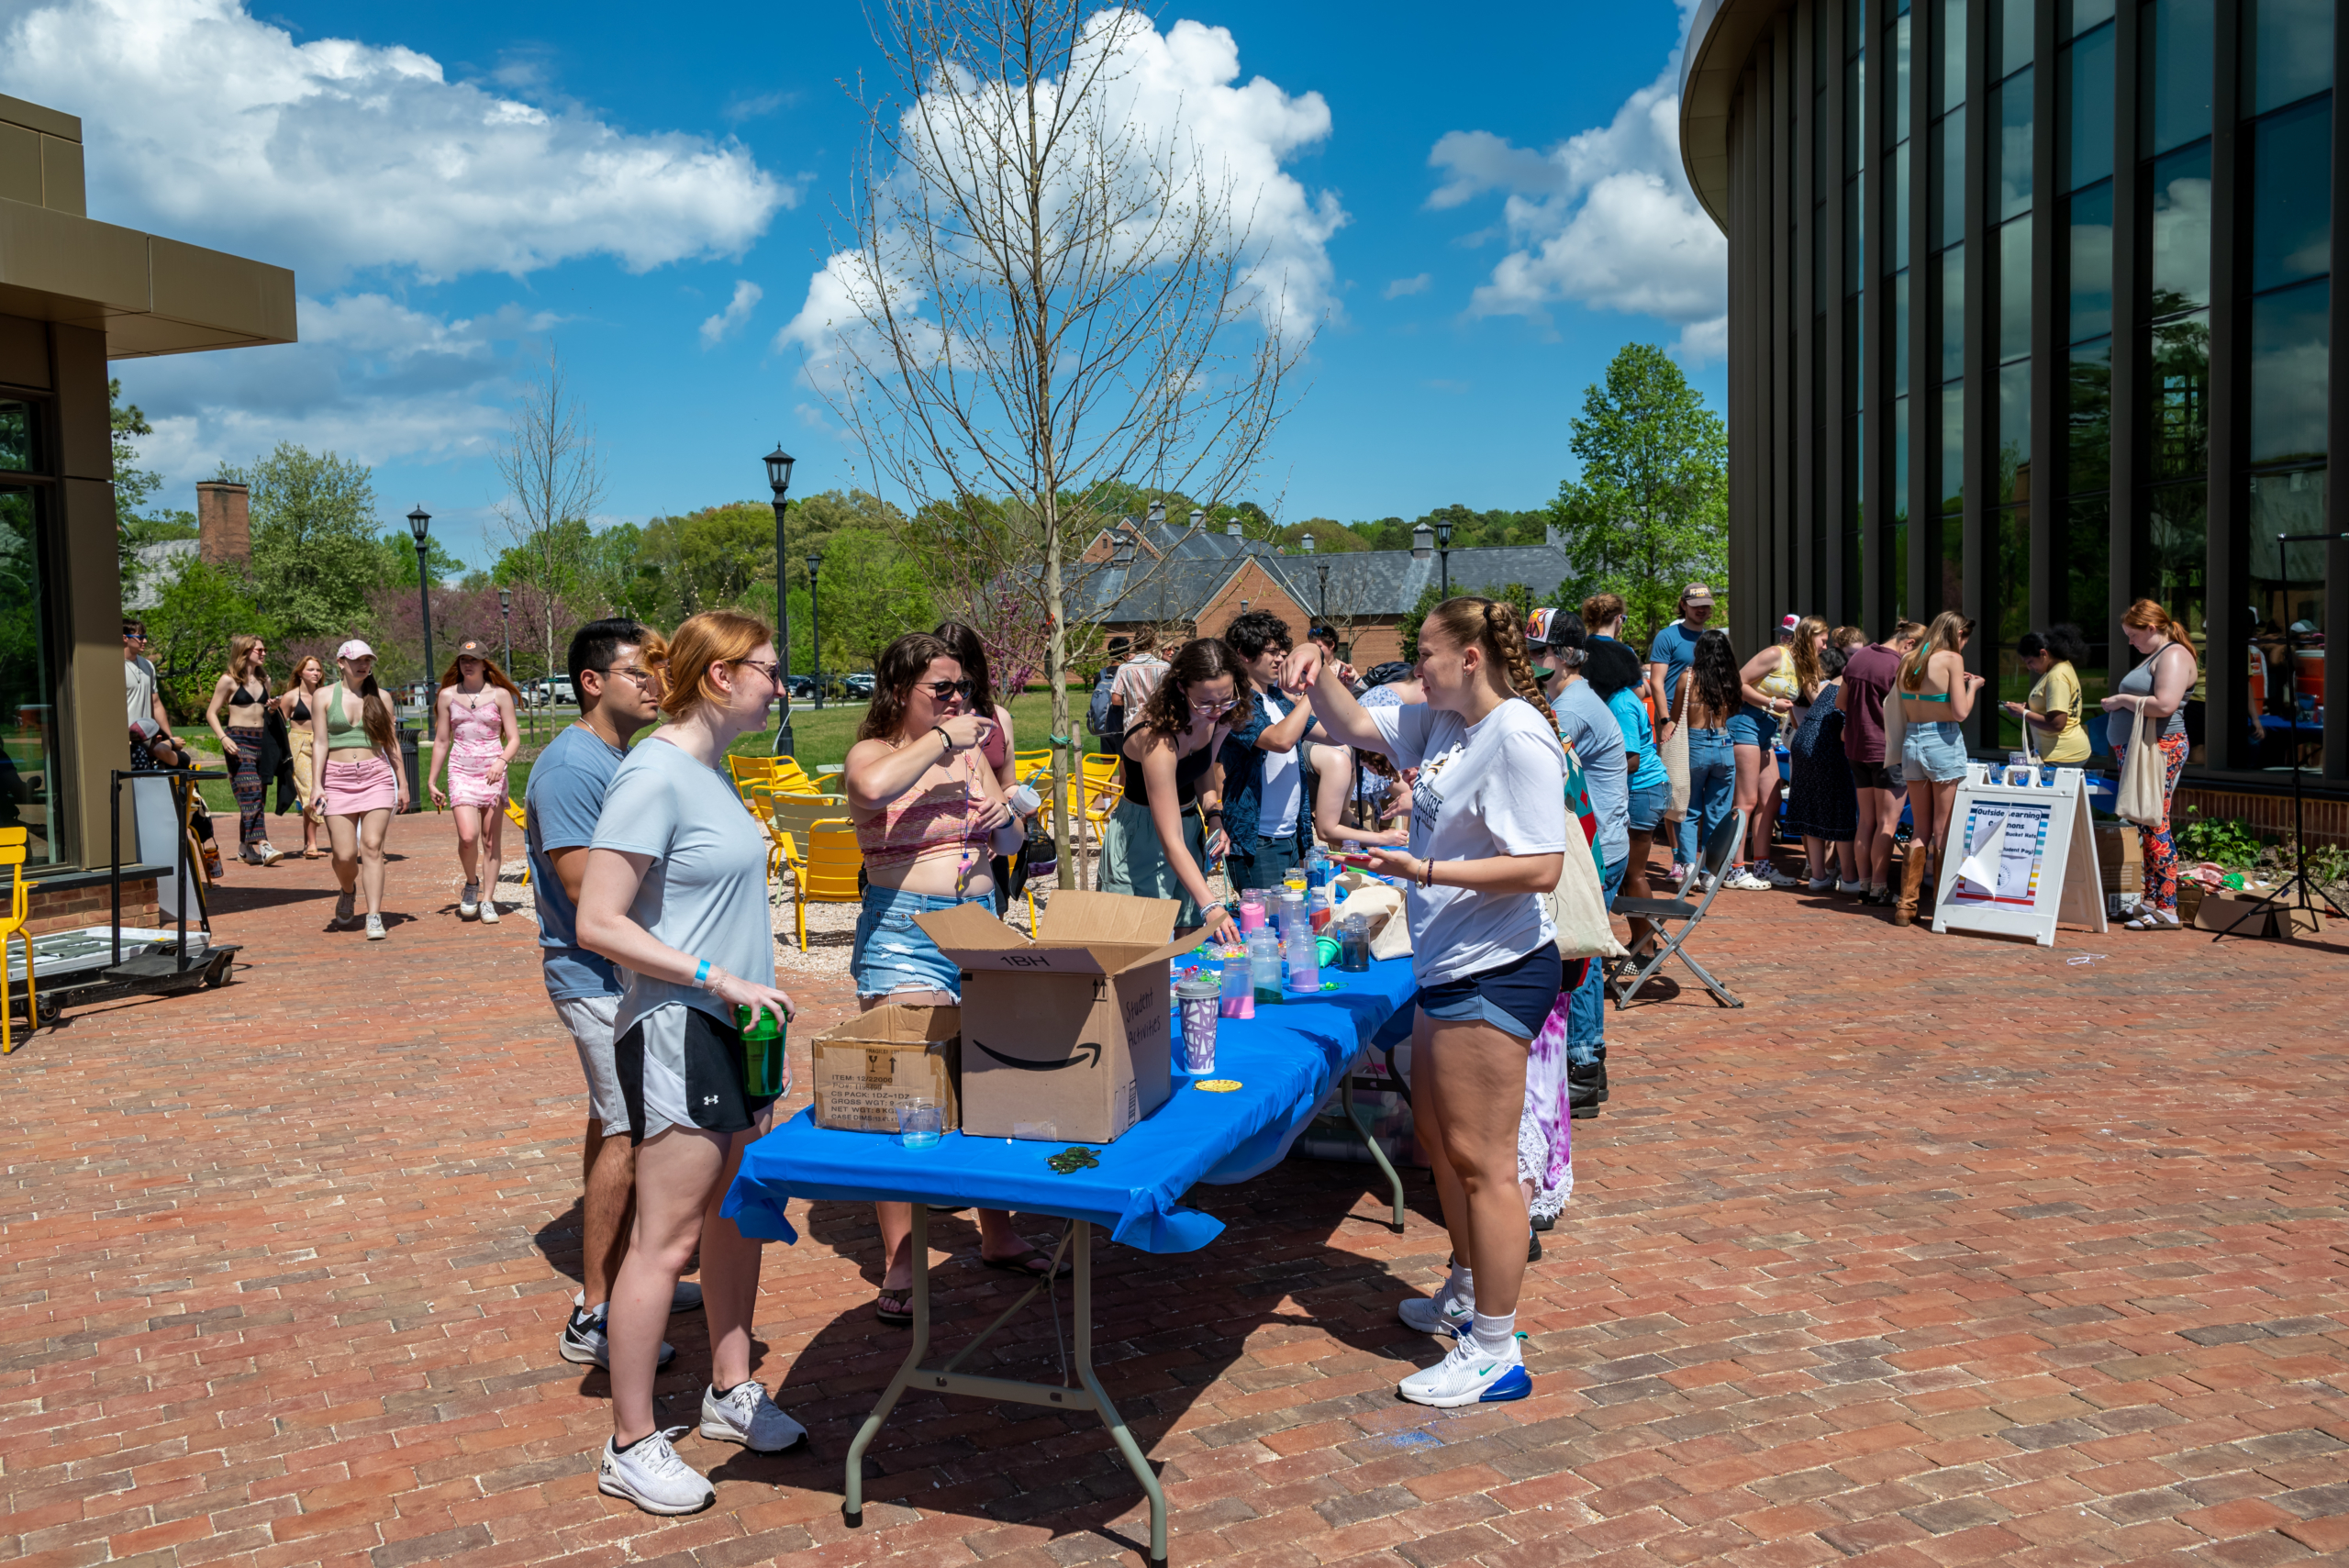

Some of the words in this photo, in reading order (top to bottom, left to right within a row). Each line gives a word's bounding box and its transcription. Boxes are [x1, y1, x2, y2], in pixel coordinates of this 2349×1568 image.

[1977, 808, 2005, 817] Outside
[2009, 811, 2040, 821] earning
[1000, 956, 1051, 966] 1BH
[1126, 986, 1153, 1023] Student
[1128, 1015, 1161, 1051] Activities
